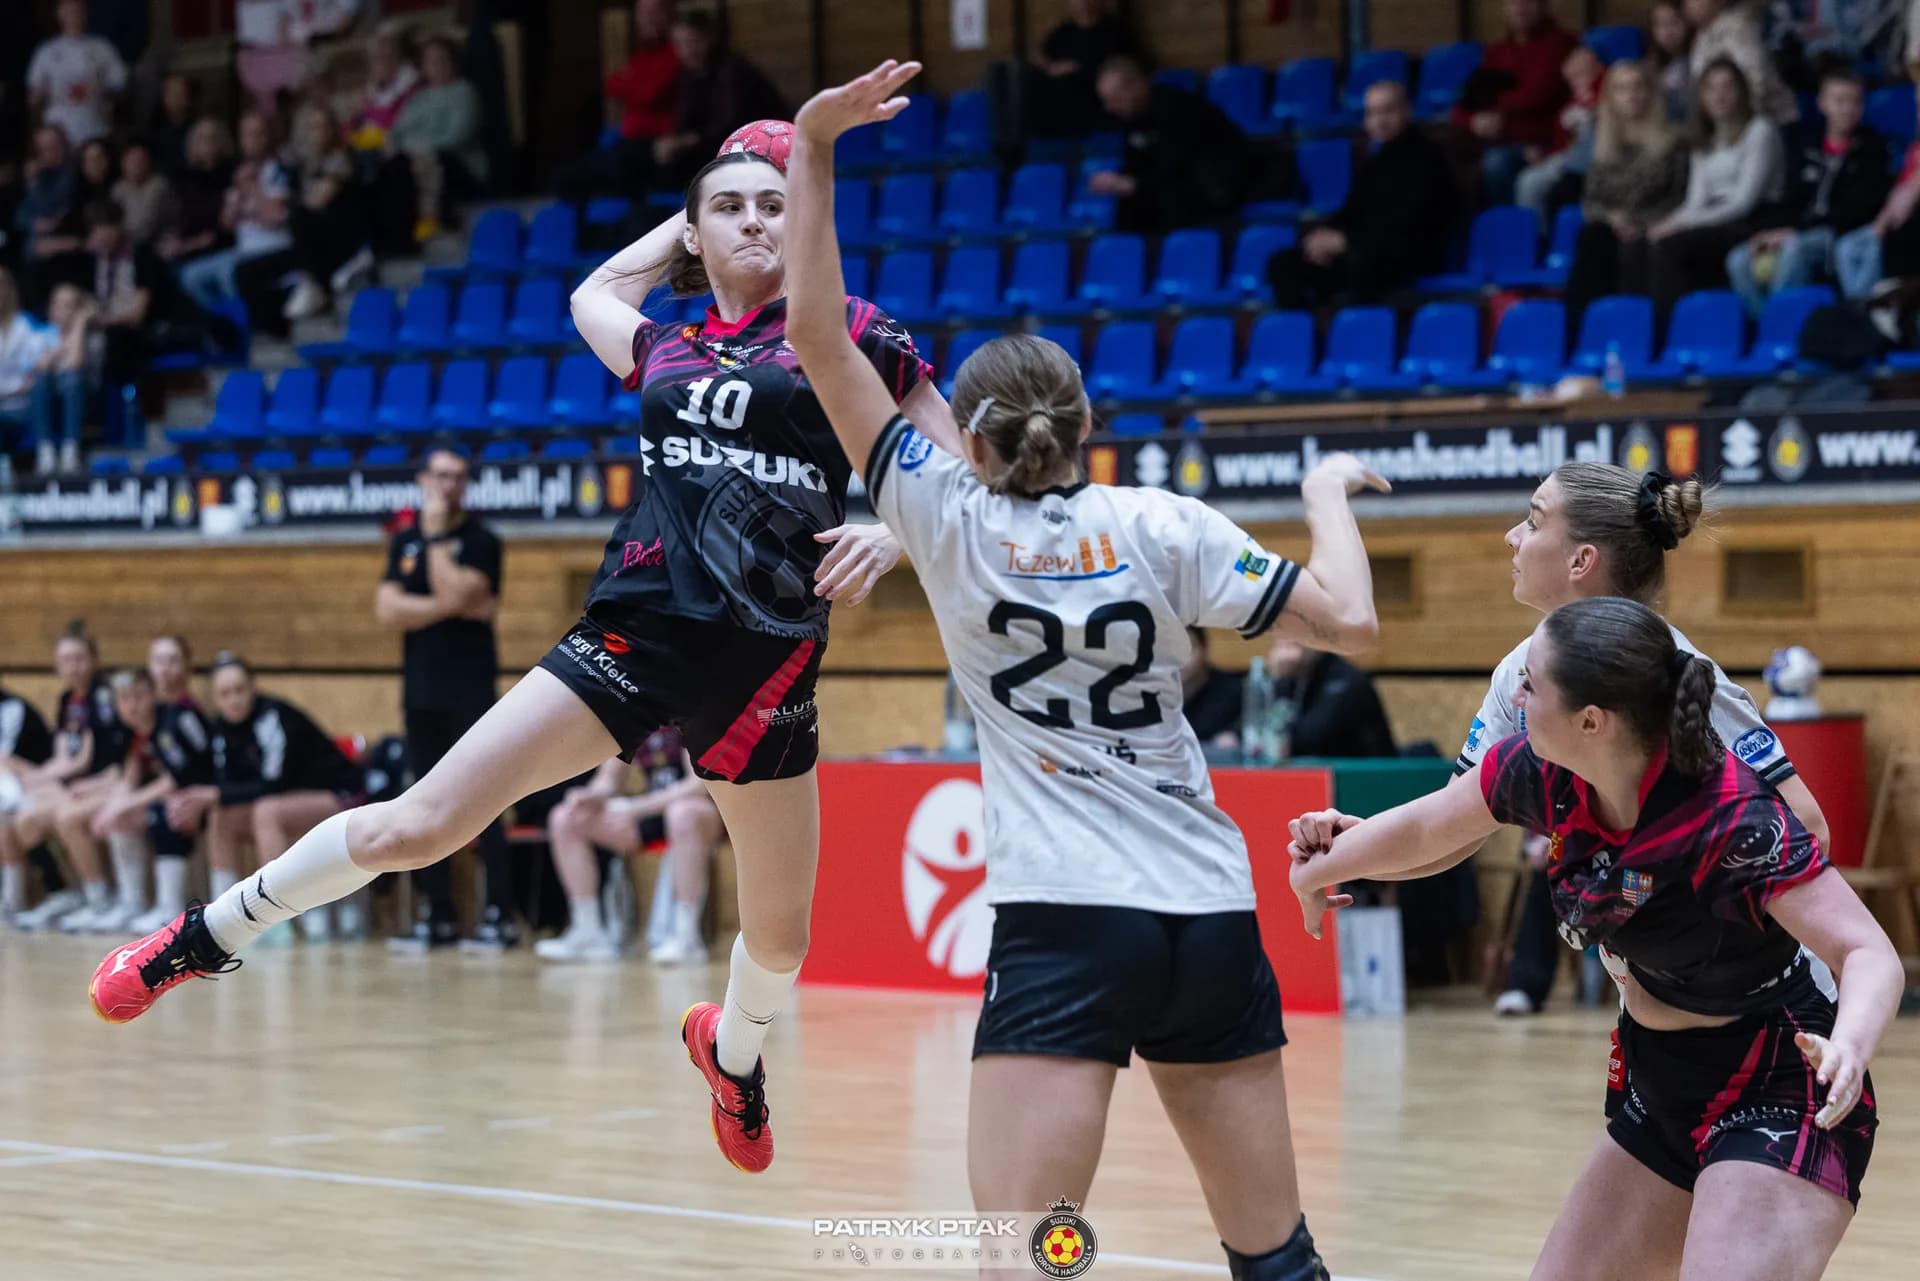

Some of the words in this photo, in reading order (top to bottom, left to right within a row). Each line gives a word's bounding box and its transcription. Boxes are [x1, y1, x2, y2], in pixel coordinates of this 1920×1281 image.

[677, 377, 753, 430] 10
[1000, 541, 1075, 573] Tczew
[592, 650, 639, 693] Kielce
[988, 601, 1162, 730] 22
